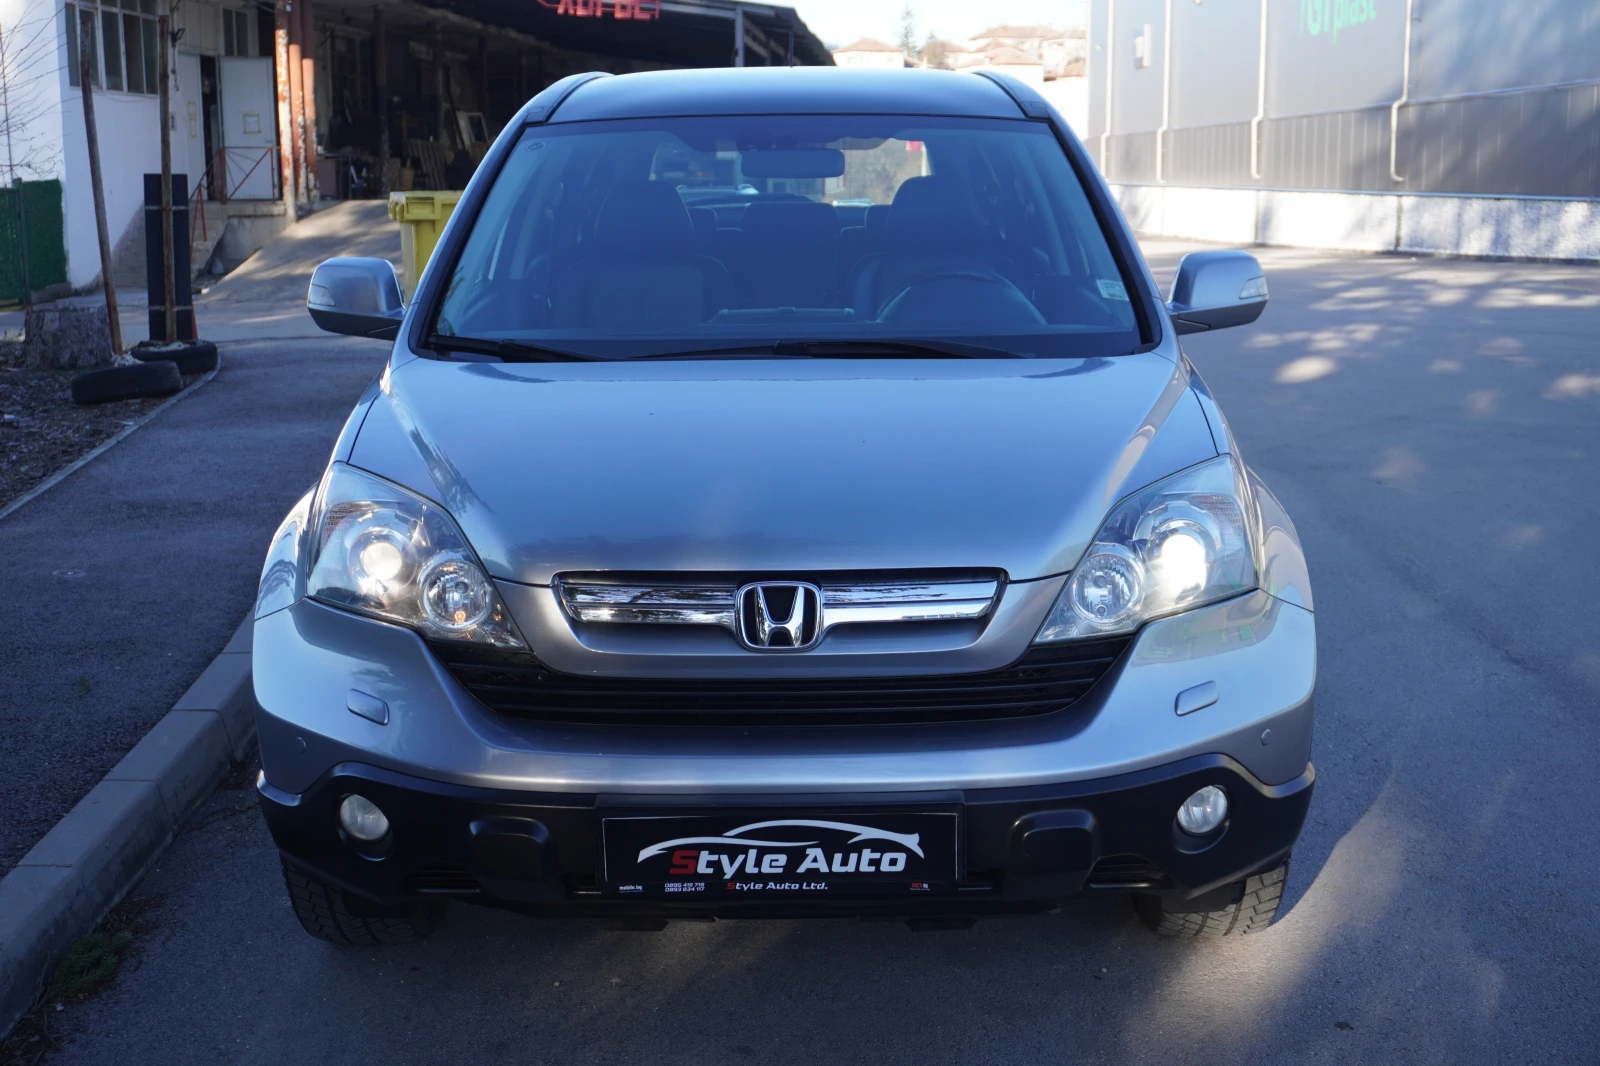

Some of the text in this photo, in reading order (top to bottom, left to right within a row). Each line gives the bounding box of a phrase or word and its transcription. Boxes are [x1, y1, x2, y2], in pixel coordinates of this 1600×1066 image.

[669, 847, 907, 879] Style Auto
[727, 882, 828, 891] Style Auto Ltd.
